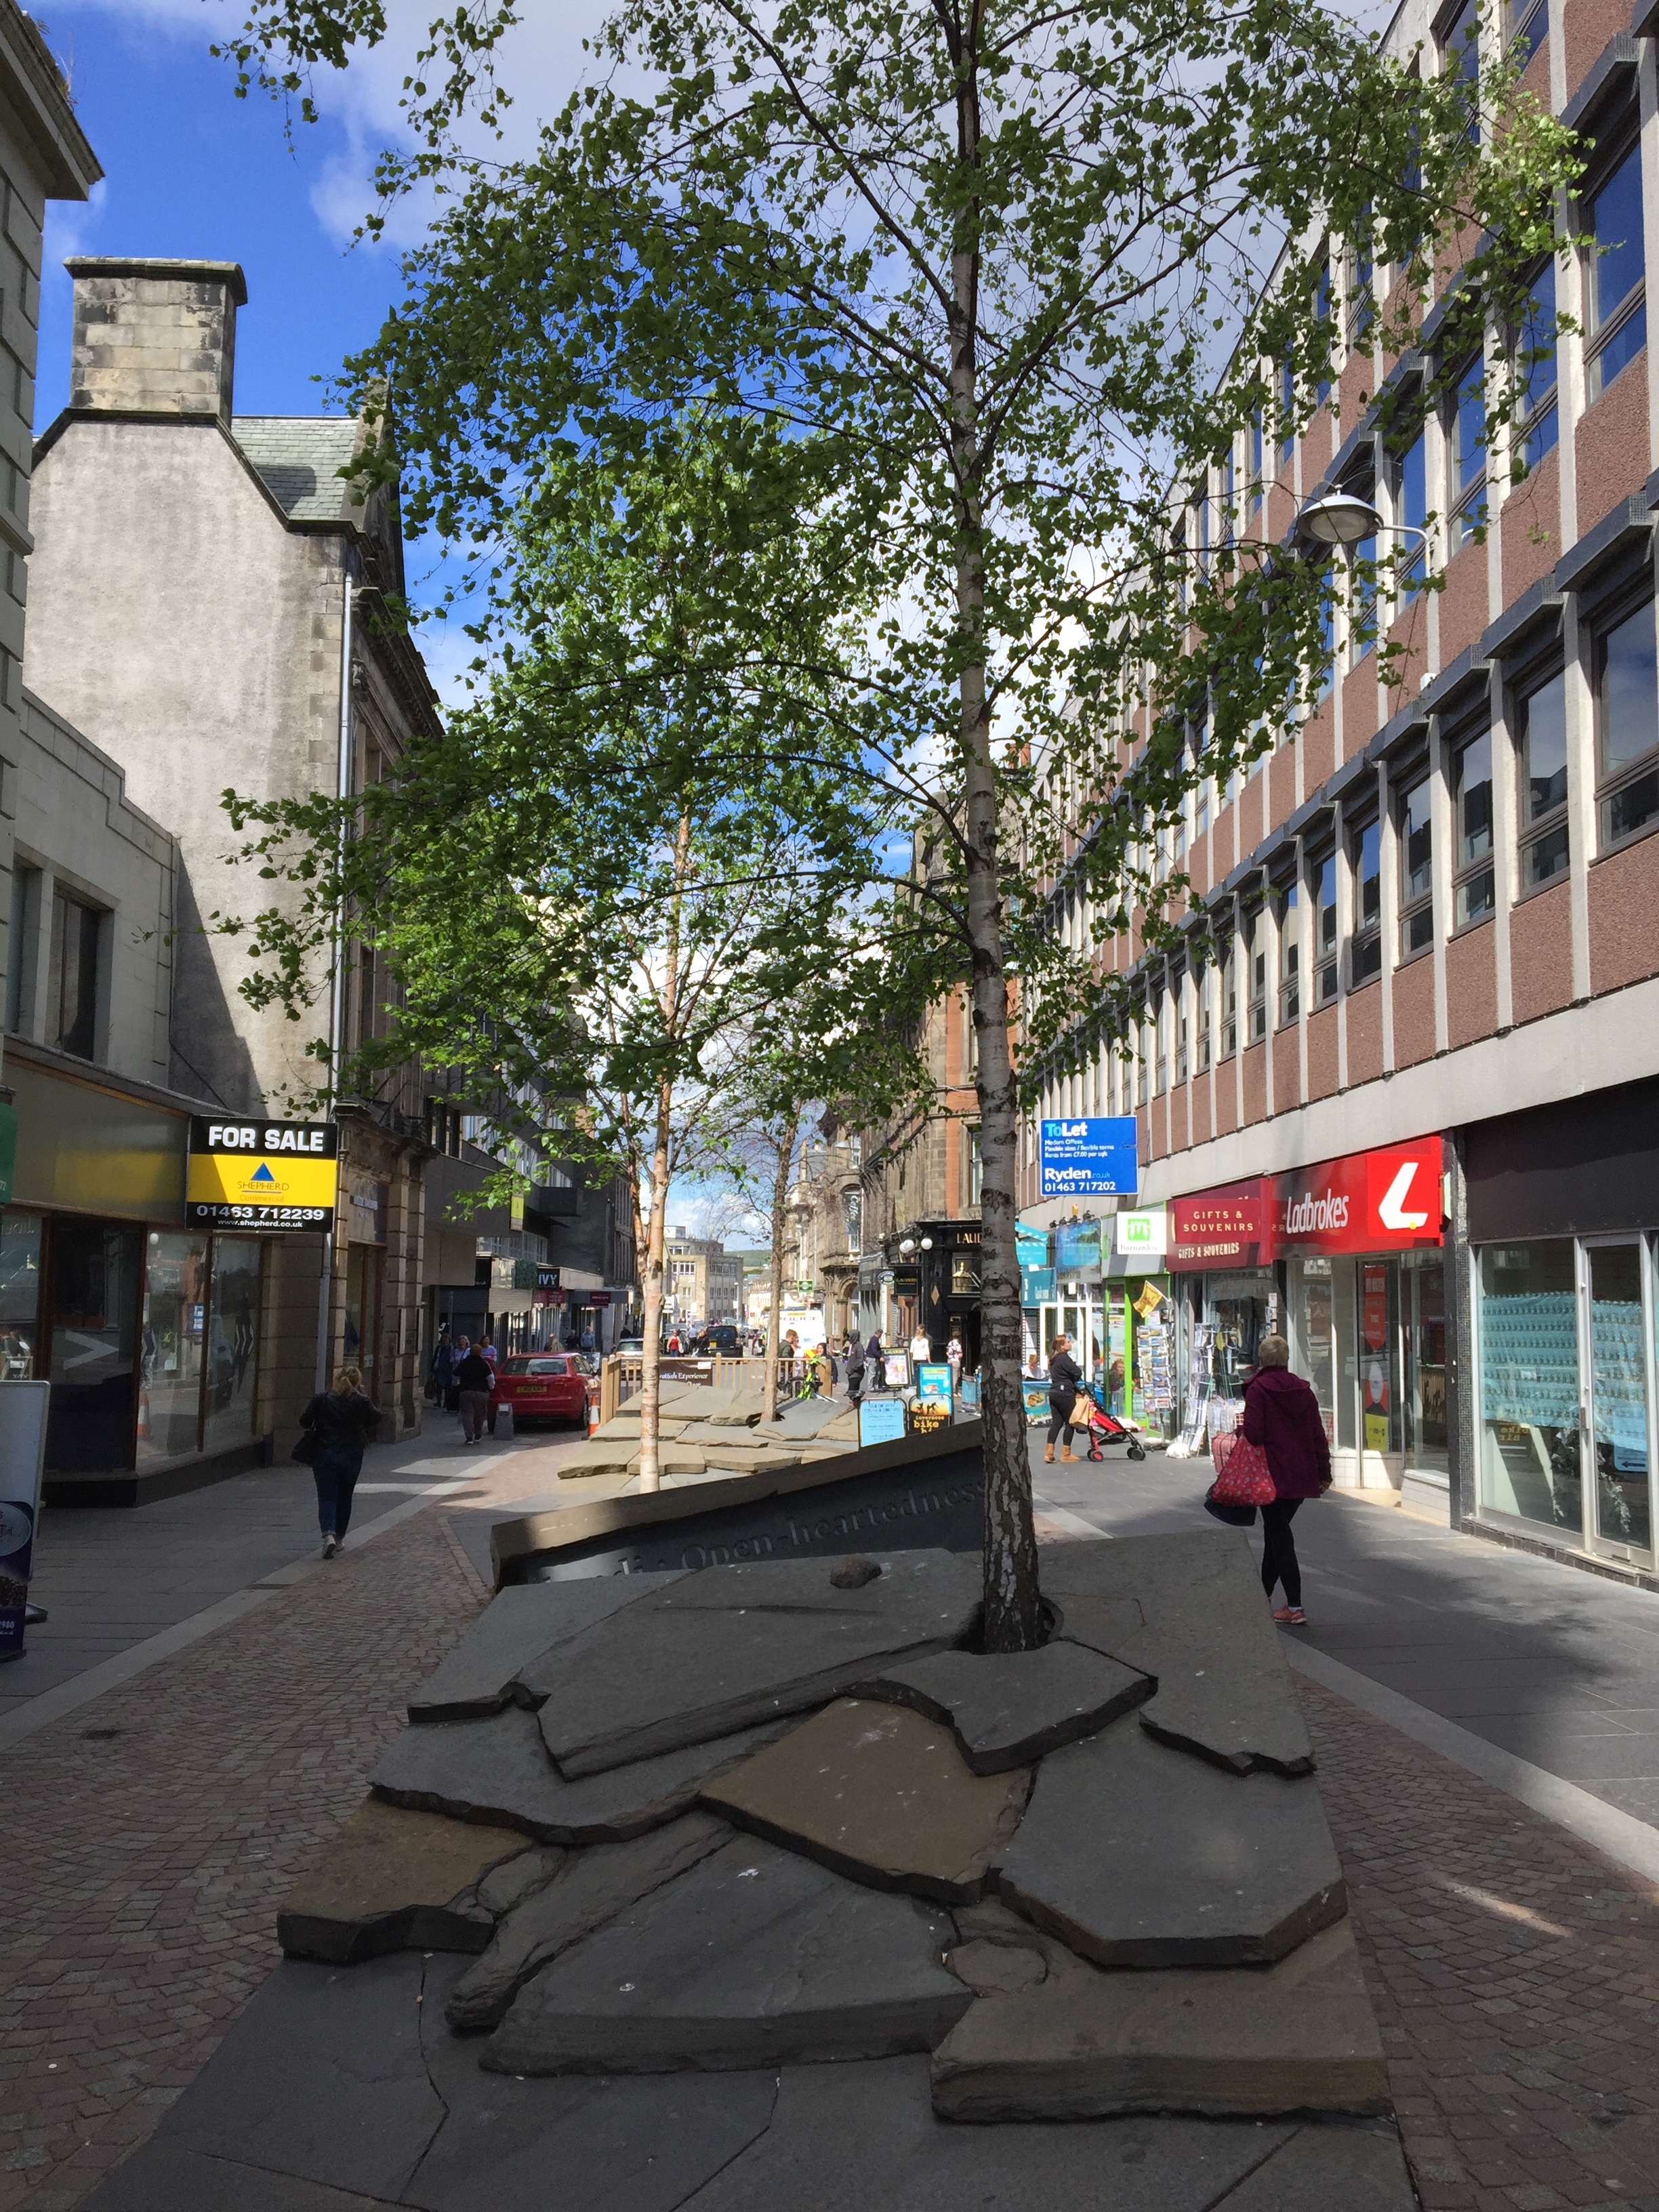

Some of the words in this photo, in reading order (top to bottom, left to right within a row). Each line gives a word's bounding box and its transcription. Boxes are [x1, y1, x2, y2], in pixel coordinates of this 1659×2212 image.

[209, 1126, 255, 1149] FOR
[265, 1130, 324, 1151] SALE
[237, 1181, 289, 1191] SHEPHERD
[1045, 1183, 1075, 1191] 01463
[1079, 1181, 1116, 1191] 717202
[197, 1205, 253, 1217] 01463
[258, 1208, 324, 1220] 712239
[1193, 1211, 1229, 1219] GIFTS
[1286, 1188, 1349, 1233] Ladbrokes
[1183, 1223, 1254, 1232] SOUVENIRS
[1179, 1248, 1195, 1259] GIFTS
[1197, 1246, 1202, 1258] &
[1203, 1242, 1240, 1257] SOUVENIRS
[538, 1273, 558, 1286] IVY
[678, 1372, 709, 1380] Experience
